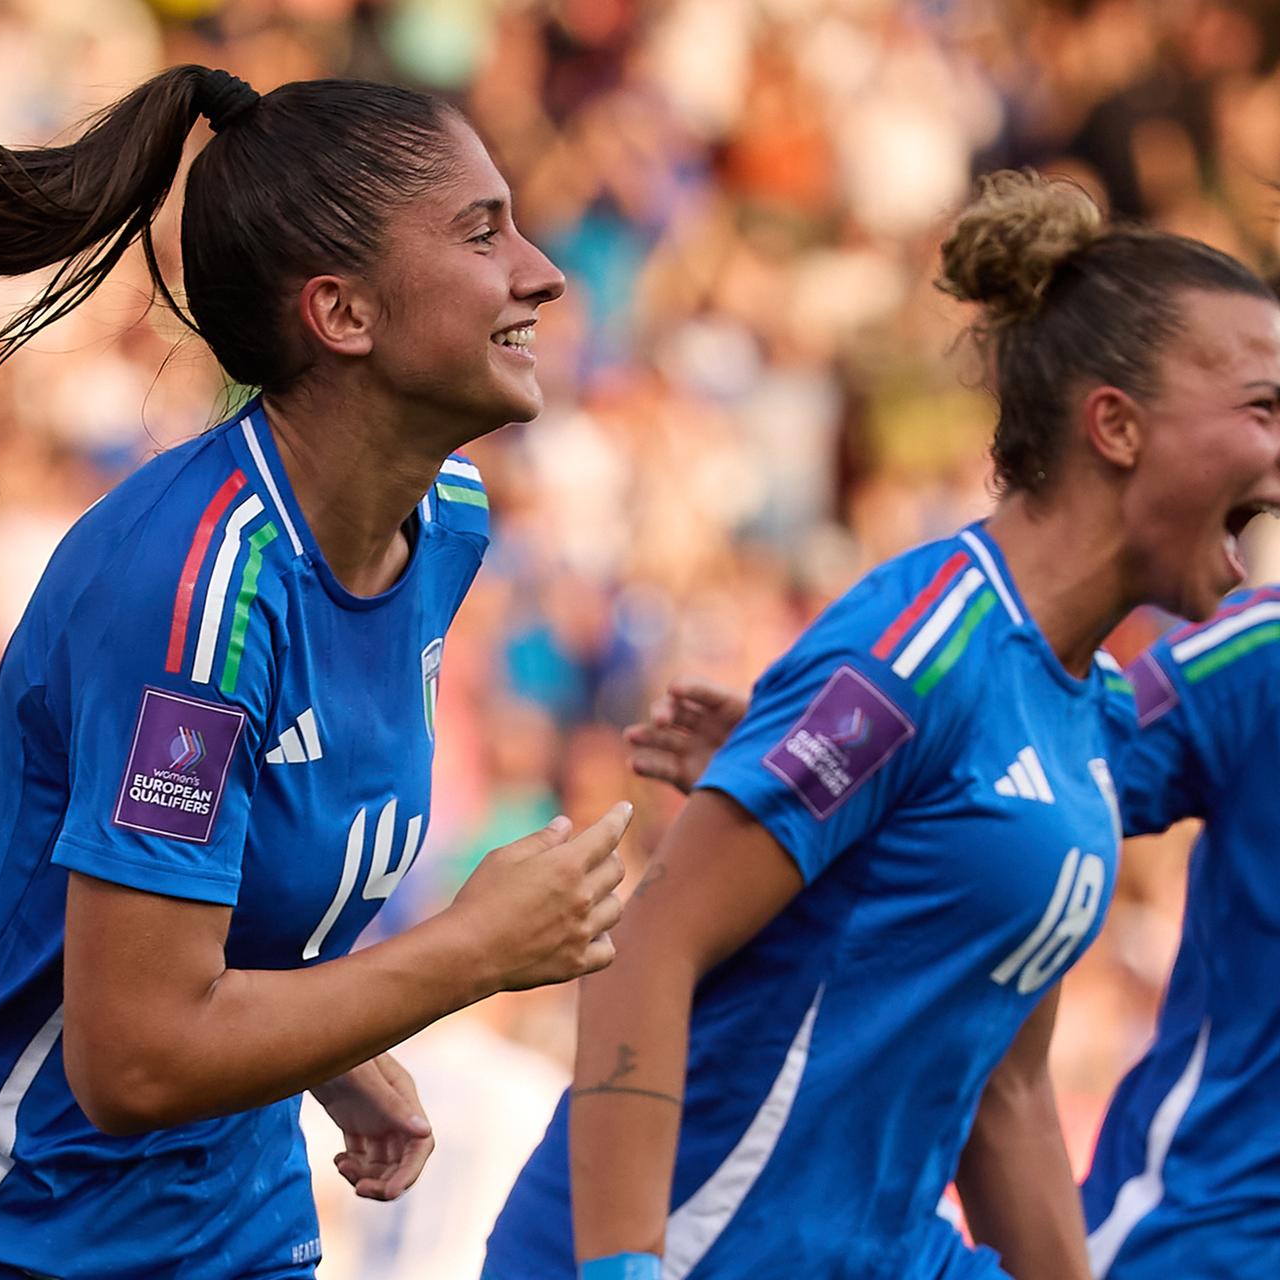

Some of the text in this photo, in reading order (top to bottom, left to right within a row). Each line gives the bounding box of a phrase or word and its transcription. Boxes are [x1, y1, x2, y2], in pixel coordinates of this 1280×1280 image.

[129, 786, 211, 815] QUALIFIERS
[133, 773, 213, 803] EUROPEAN
[302, 798, 423, 961] 14
[989, 846, 1106, 995] 18
